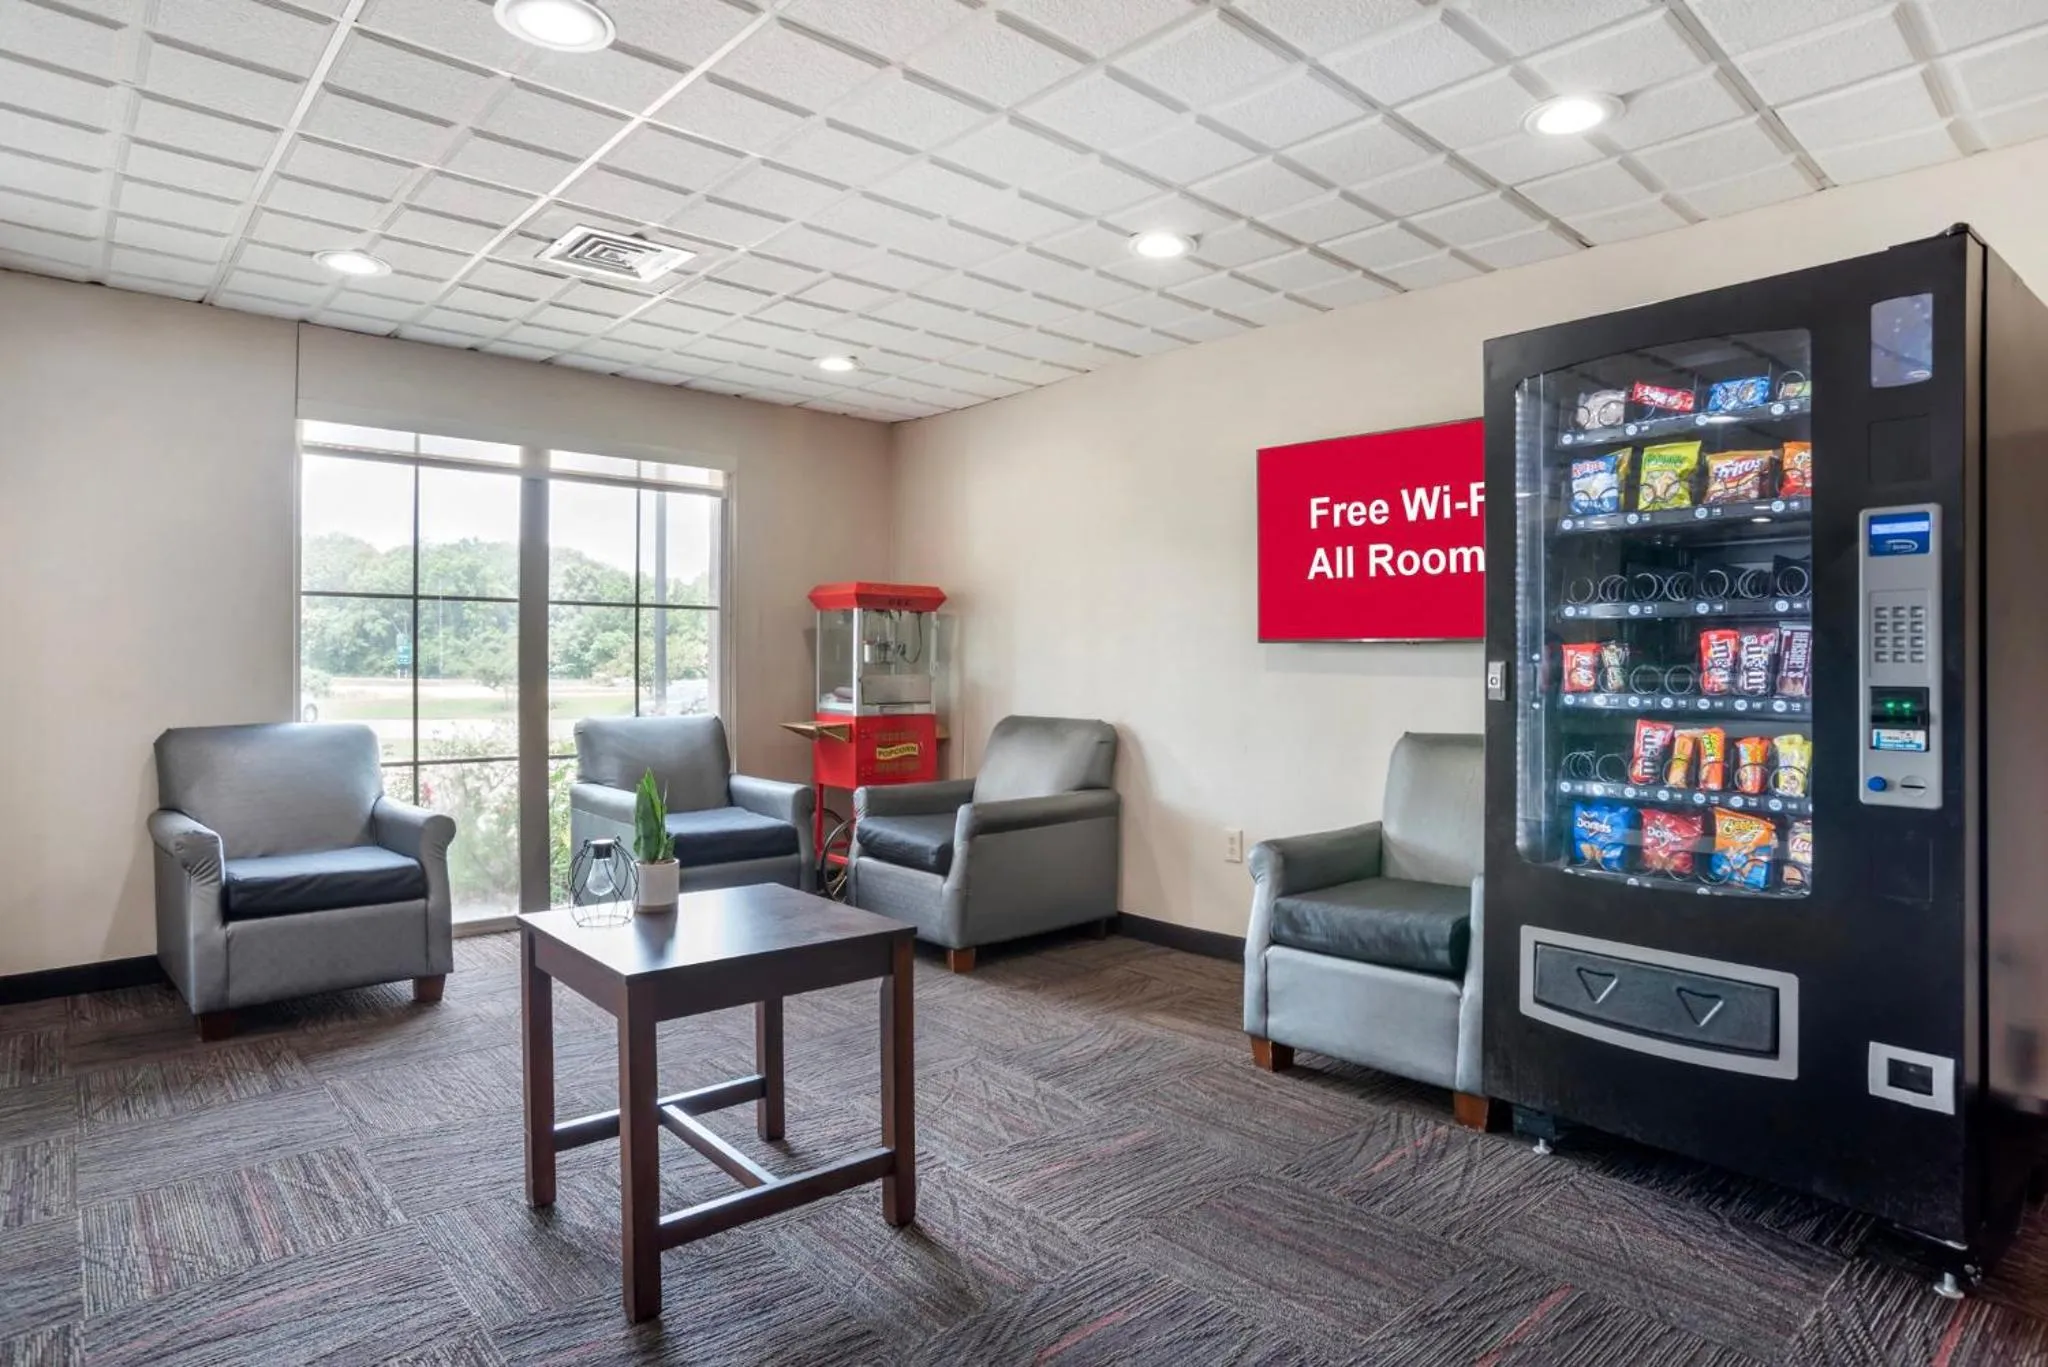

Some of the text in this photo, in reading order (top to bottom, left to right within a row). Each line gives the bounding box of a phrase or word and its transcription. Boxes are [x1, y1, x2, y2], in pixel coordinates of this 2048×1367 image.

[1309, 496, 1390, 530] Free
[1307, 543, 1486, 581] All Room
[878, 745, 917, 758] POPCORN
